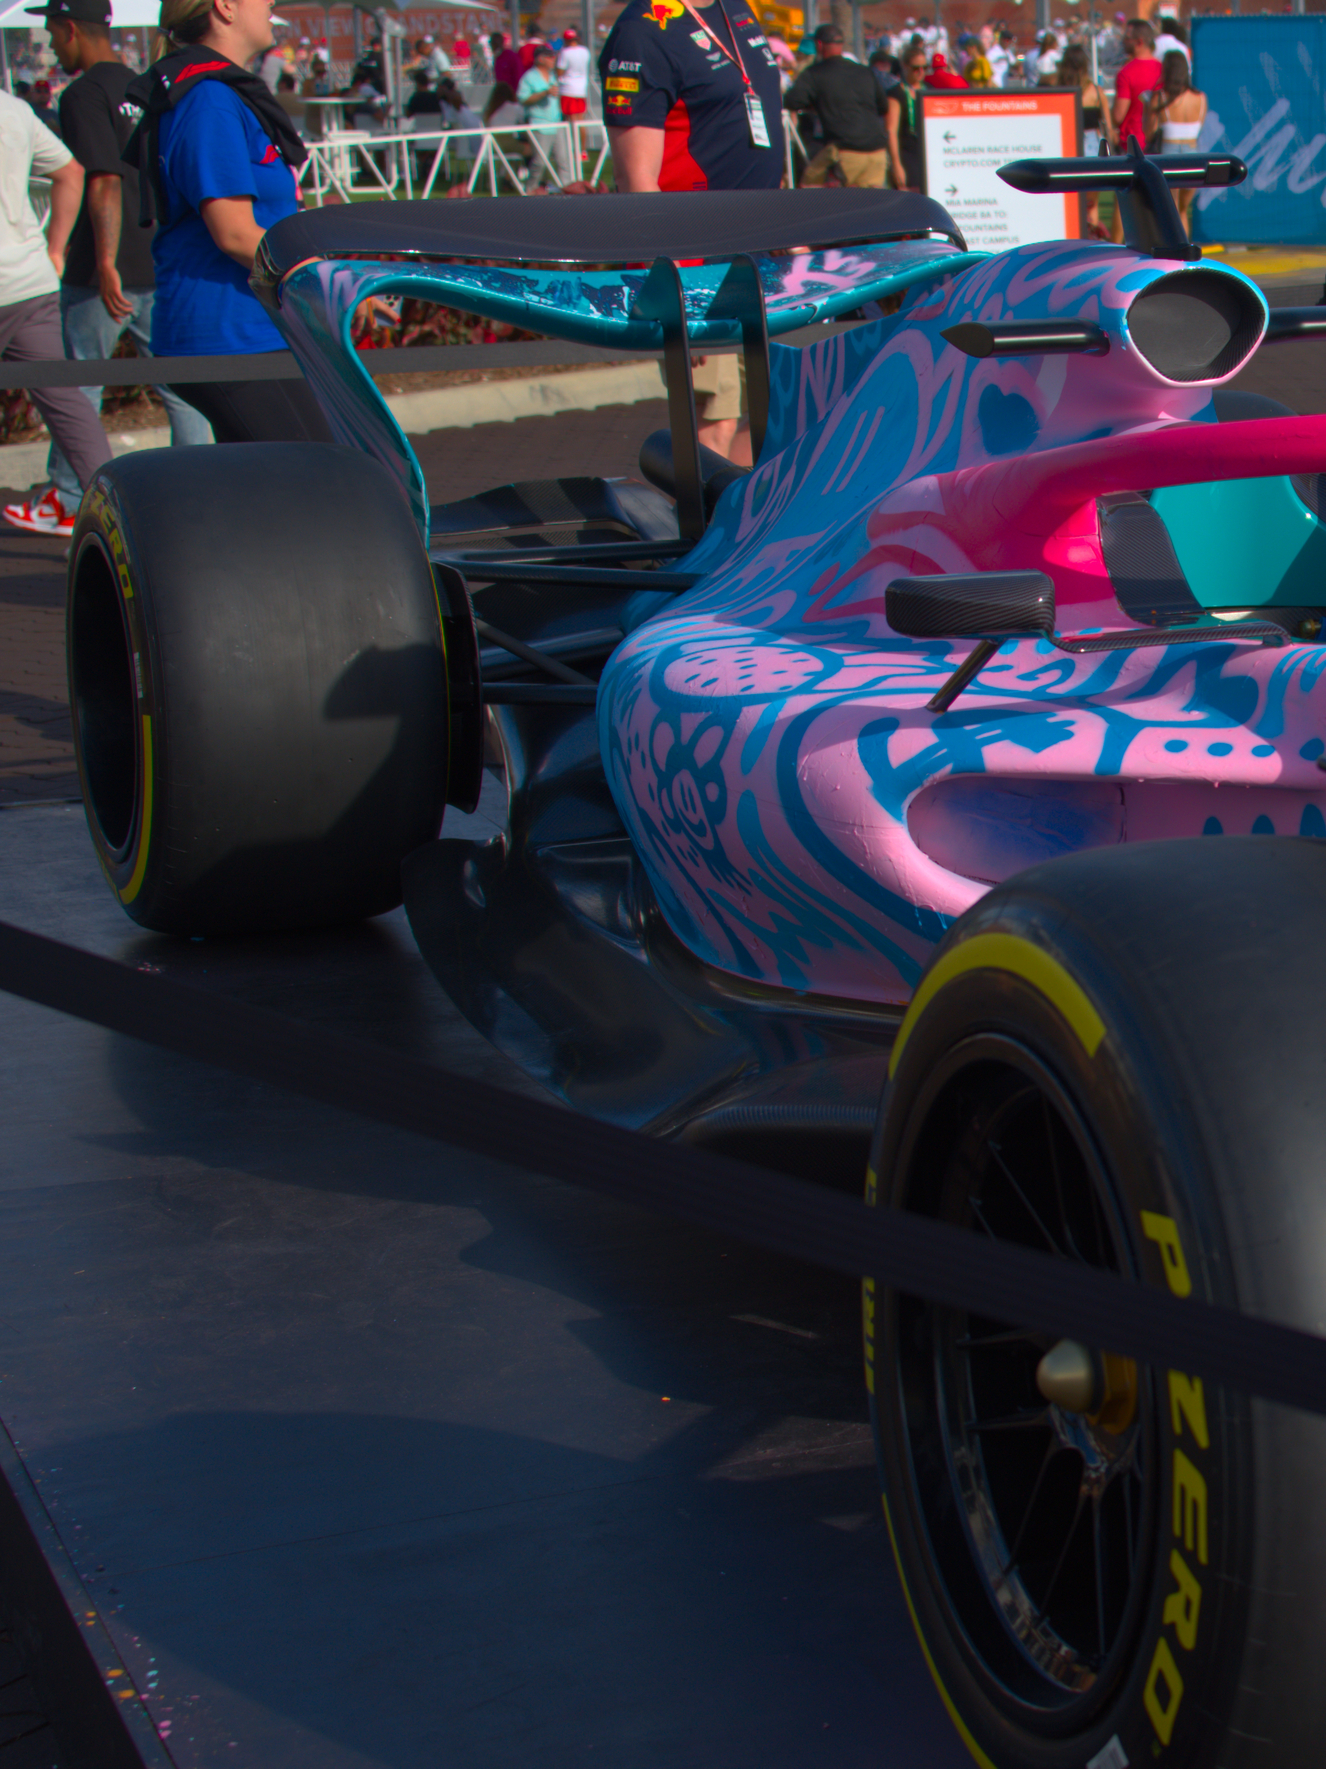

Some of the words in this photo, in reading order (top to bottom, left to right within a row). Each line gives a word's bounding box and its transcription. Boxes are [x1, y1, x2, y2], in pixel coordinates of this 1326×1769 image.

[618, 60, 642, 72] AT&T
[961, 102, 981, 112] THE
[982, 100, 1038, 111] FOUNTAINS
[943, 146, 985, 155] MCLAREN
[987, 145, 1009, 154] RACE
[1012, 144, 1043, 153] HOUSE
[943, 158, 1001, 168] CRYPTO.COM
[963, 198, 997, 206] MARINA
[951, 211, 978, 219] RIDGE
[965, 236, 980, 245] AST
[982, 236, 1020, 245] CAMPUS
[1142, 1369, 1210, 1747] ZERO
